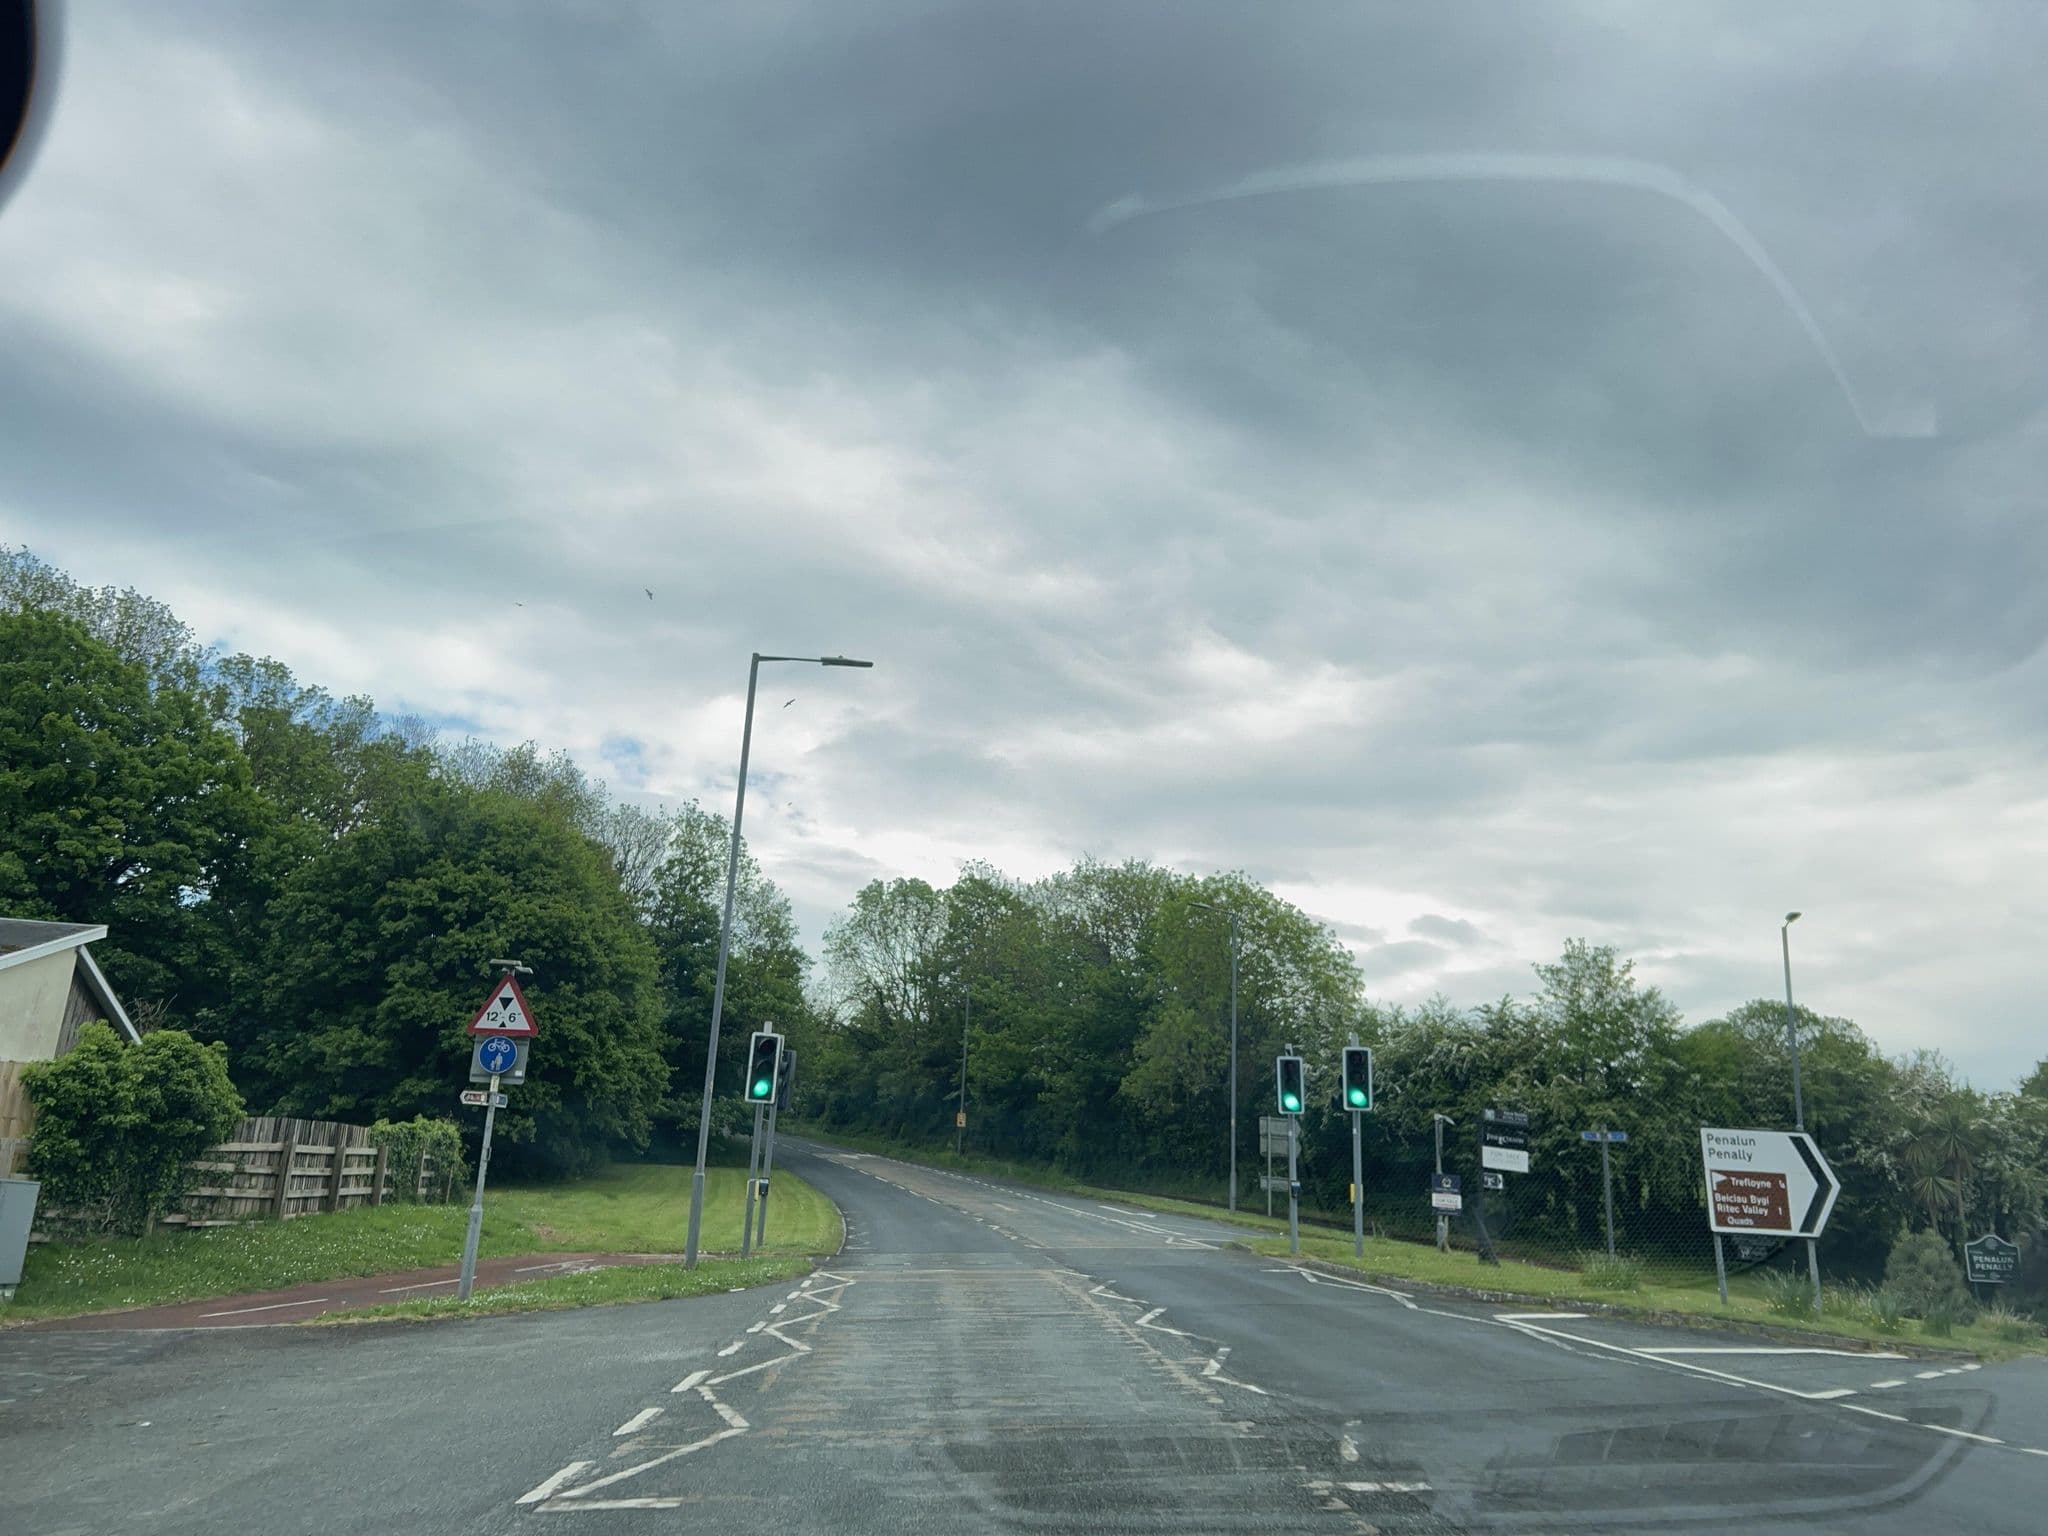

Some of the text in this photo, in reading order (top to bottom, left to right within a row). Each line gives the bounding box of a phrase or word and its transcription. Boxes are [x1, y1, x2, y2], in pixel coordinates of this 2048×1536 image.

[1706, 1133, 1756, 1146] Penalun
[1708, 1147, 1753, 1163] Penally
[1730, 1177, 1772, 1189] Trefloyne
[1716, 1203, 1740, 1213] Ritec
[1742, 1204, 1769, 1216] Valley
[1727, 1216, 1754, 1226] Quads
[1972, 1255, 2014, 1264] PENALUN
[1975, 1263, 2013, 1271] PENALLY
